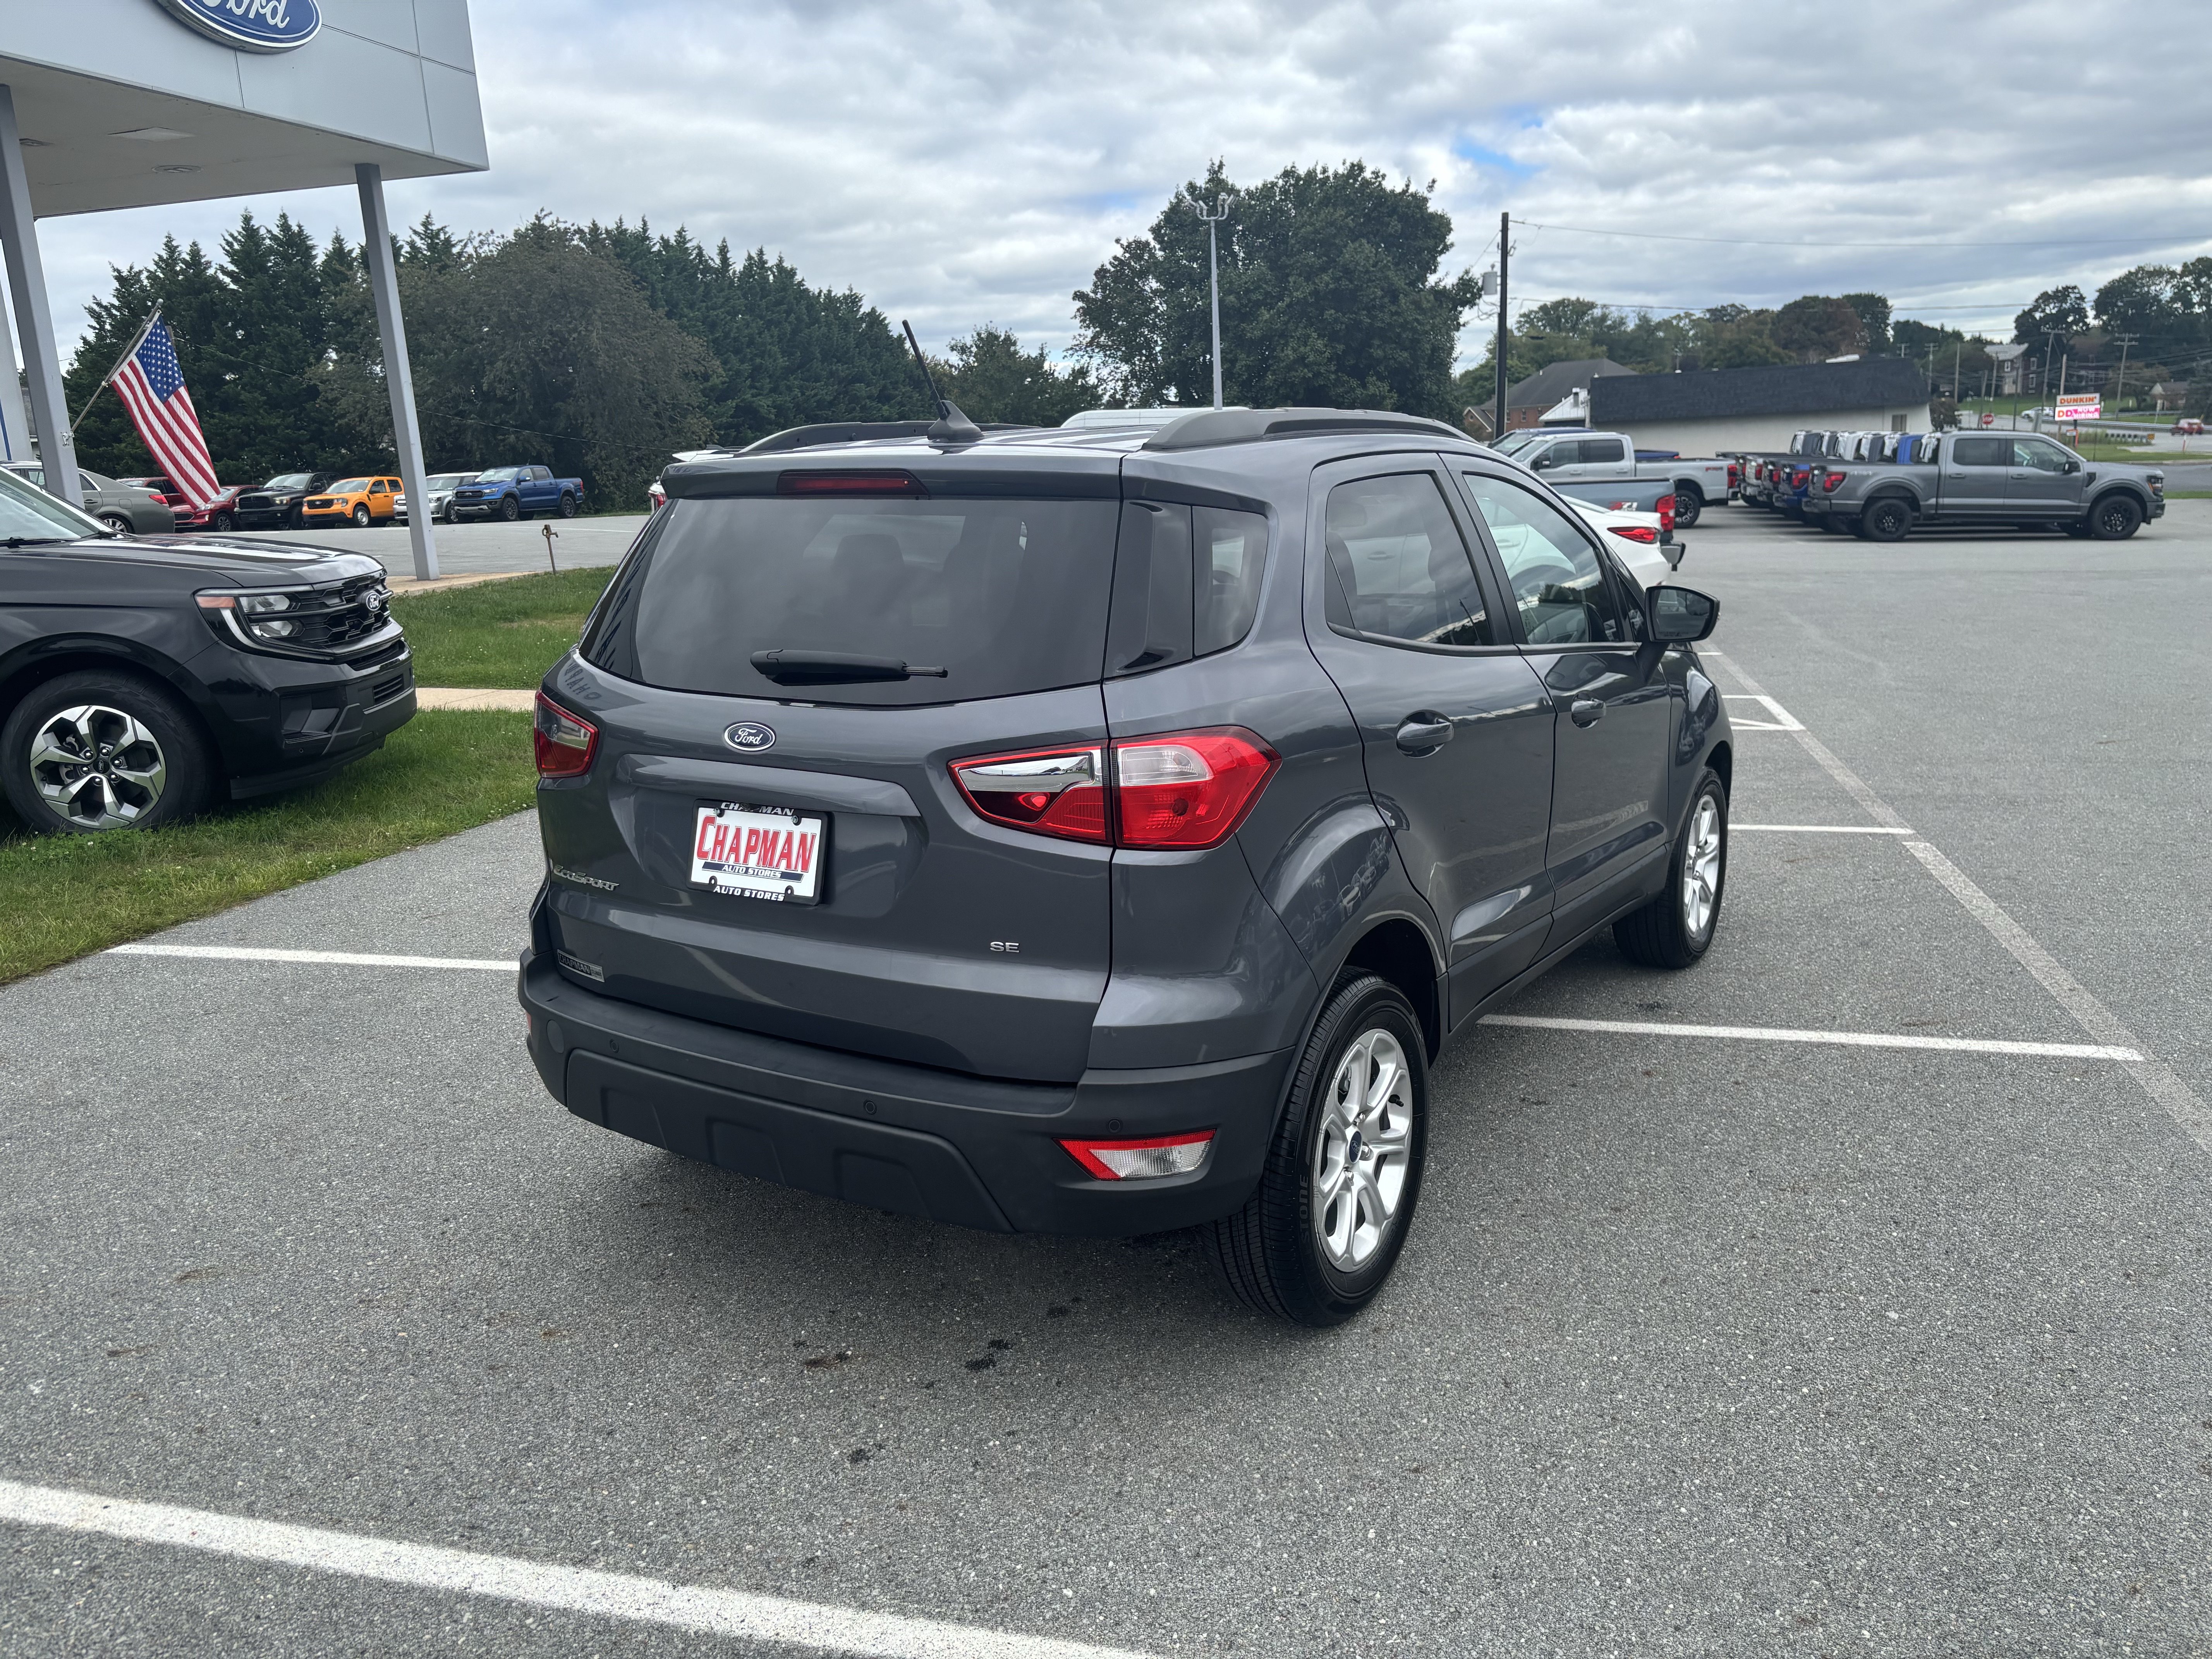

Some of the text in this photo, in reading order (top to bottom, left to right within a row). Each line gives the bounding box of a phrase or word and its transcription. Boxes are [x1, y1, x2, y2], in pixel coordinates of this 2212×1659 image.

[202, 0, 290, 29] ord
[2059, 396, 2097, 404] DUNKIN'
[735, 728, 763, 745] Ford
[721, 802, 794, 816] CHMAN
[696, 815, 817, 873] CHAPMAN
[721, 864, 782, 878] AUTO STORES
[713, 885, 785, 902] AUTO STORES
[990, 941, 1019, 953] SE
[559, 954, 591, 974] CHAPMAN
